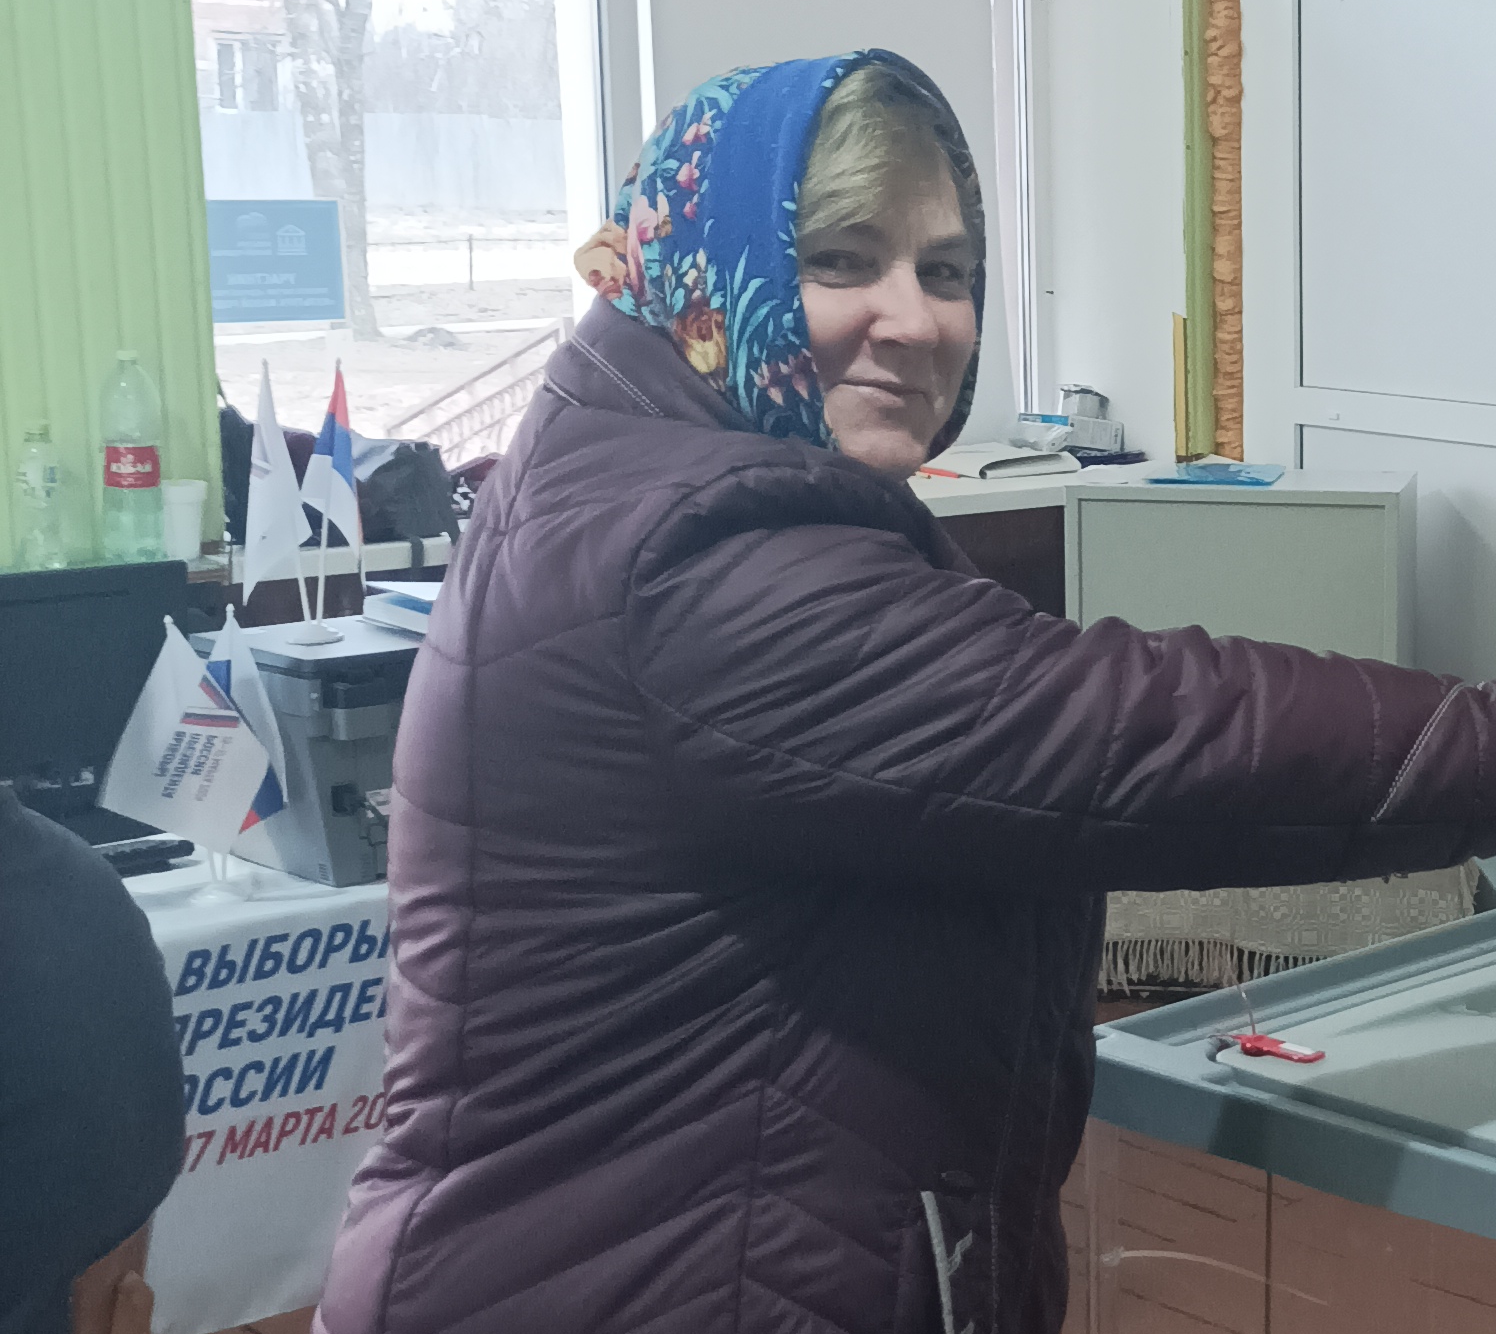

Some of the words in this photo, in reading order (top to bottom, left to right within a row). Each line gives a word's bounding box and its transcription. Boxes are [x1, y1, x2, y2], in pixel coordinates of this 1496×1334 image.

[174, 919, 391, 998] ВЫБОРЫ
[173, 976, 387, 1056] ПРЕЗИДЕ
[216, 1102, 338, 1165] МАРТА
